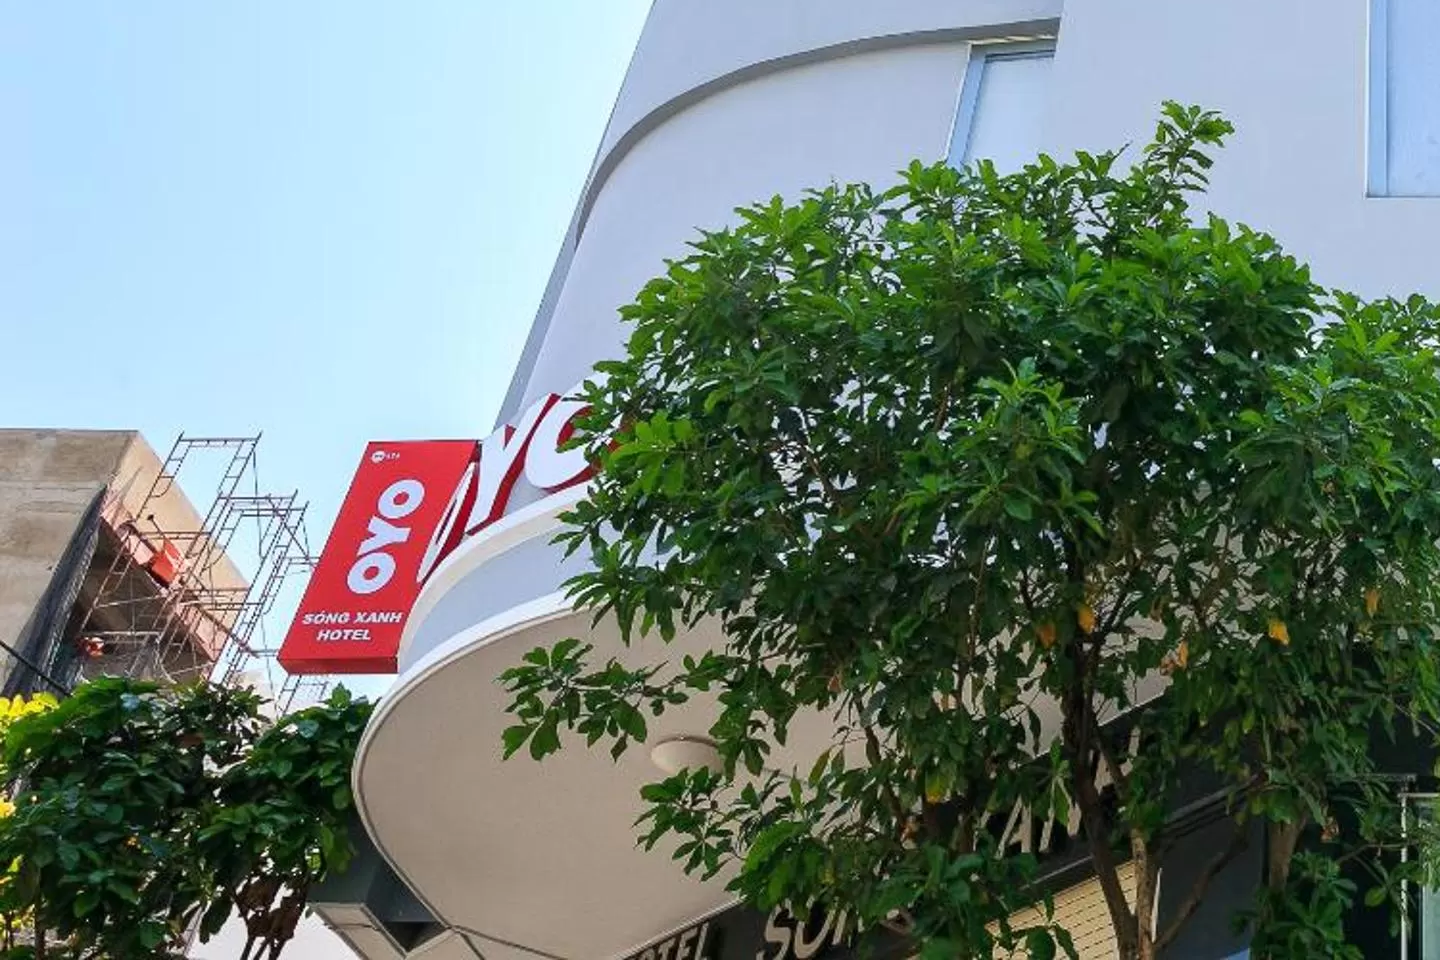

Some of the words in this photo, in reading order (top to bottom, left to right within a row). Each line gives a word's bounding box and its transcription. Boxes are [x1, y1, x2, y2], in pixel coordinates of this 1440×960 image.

[346, 479, 425, 594] OYO
[353, 612, 402, 623] XANH
[316, 629, 371, 641] HOTEL
